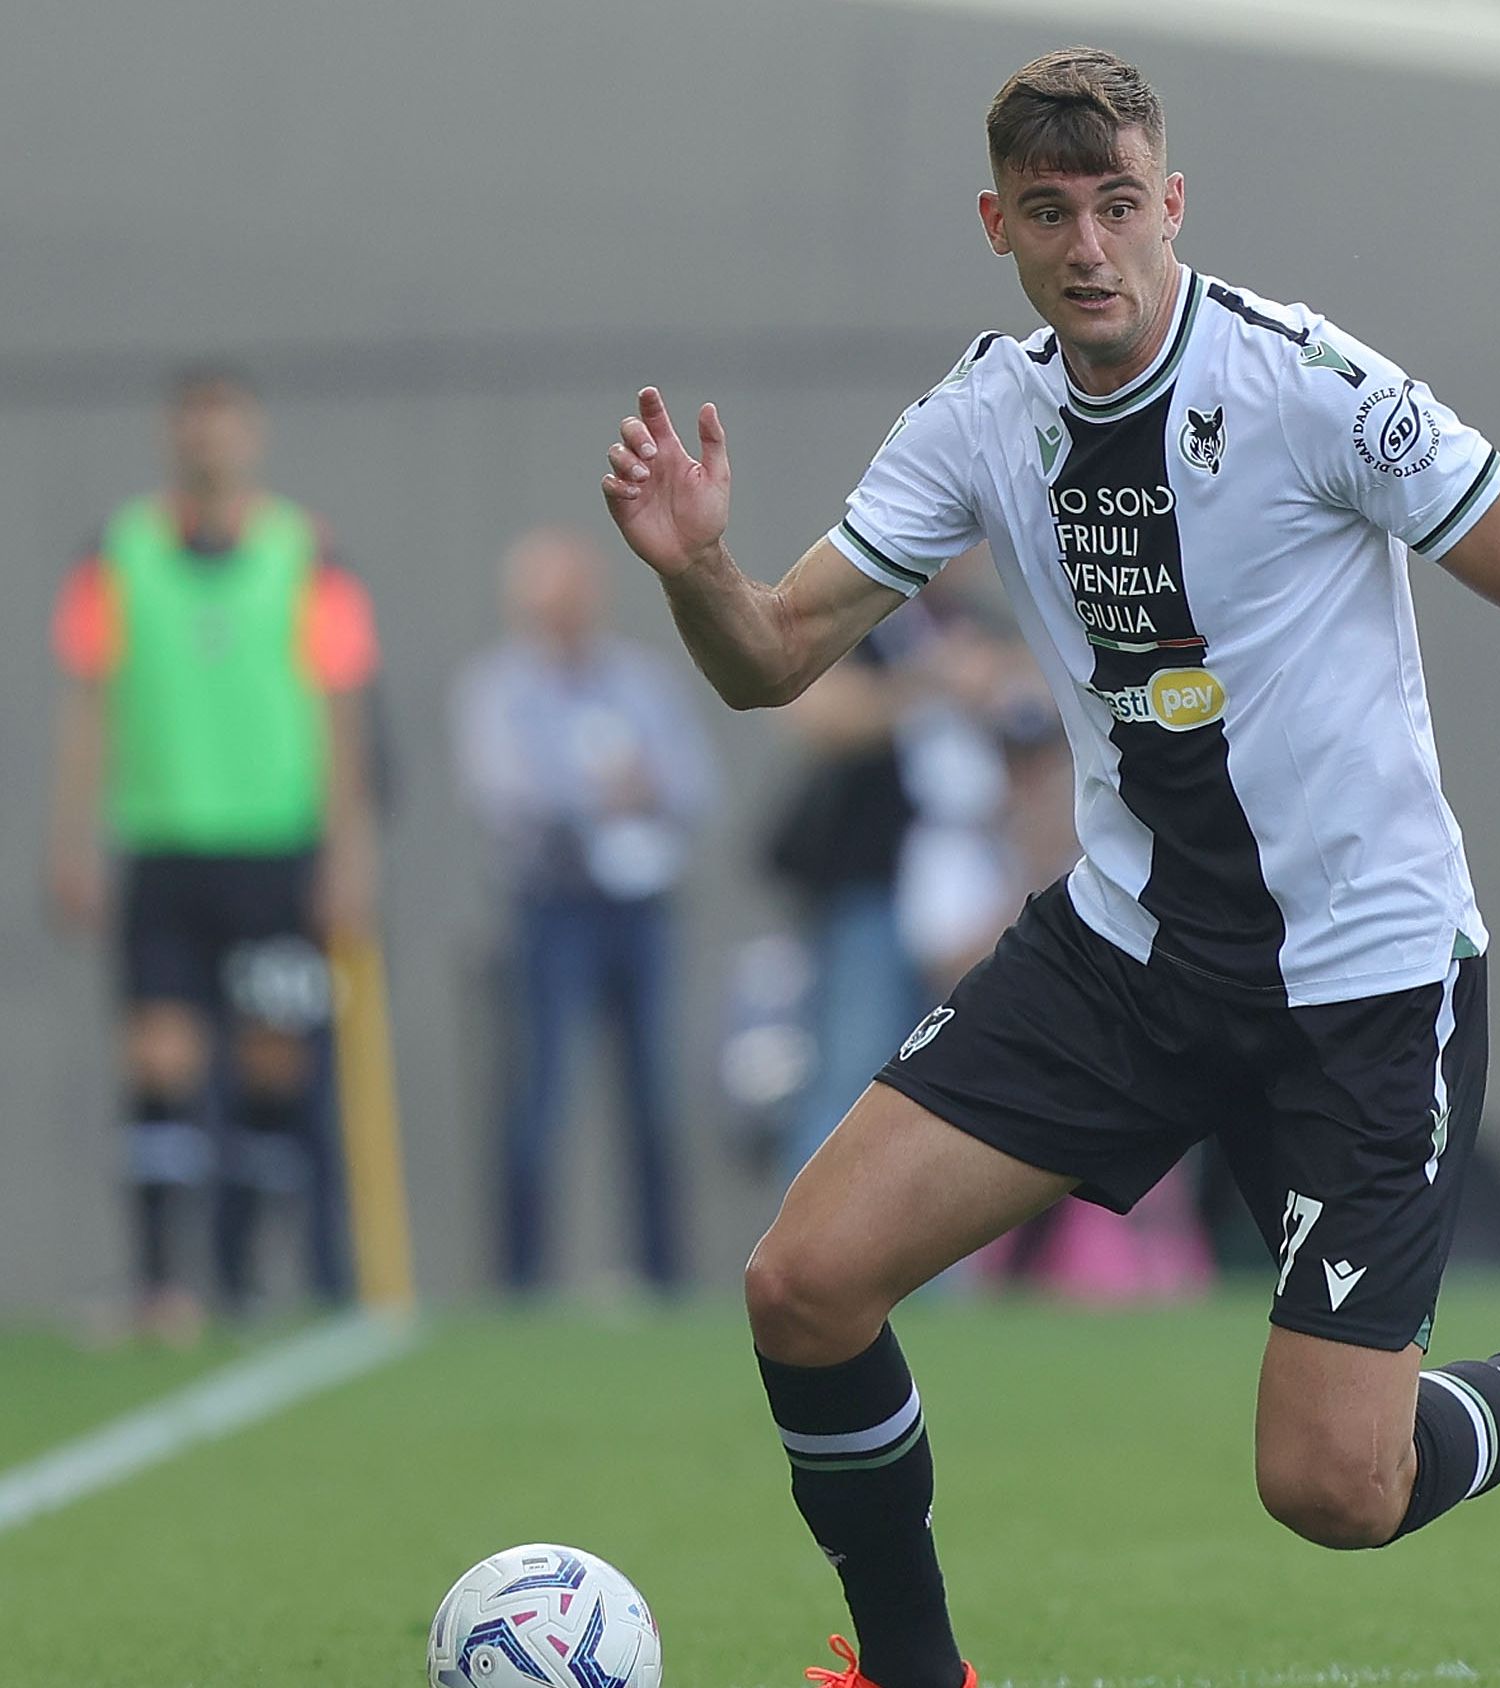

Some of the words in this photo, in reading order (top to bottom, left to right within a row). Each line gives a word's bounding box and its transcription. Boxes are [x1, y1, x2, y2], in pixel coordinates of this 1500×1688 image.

[1353, 387, 1397, 434] DANIELE
[1353, 438, 1375, 464] SAN
[1388, 416, 1413, 453] SD
[1392, 410, 1441, 478] PROSCIUTTO
[1373, 461, 1390, 474] DI
[1050, 486, 1088, 514] IO
[1097, 485, 1175, 517] SONO
[1057, 524, 1139, 557] FRIULI
[1062, 561, 1177, 596] VENEZIA
[1076, 600, 1157, 634] GIULIA
